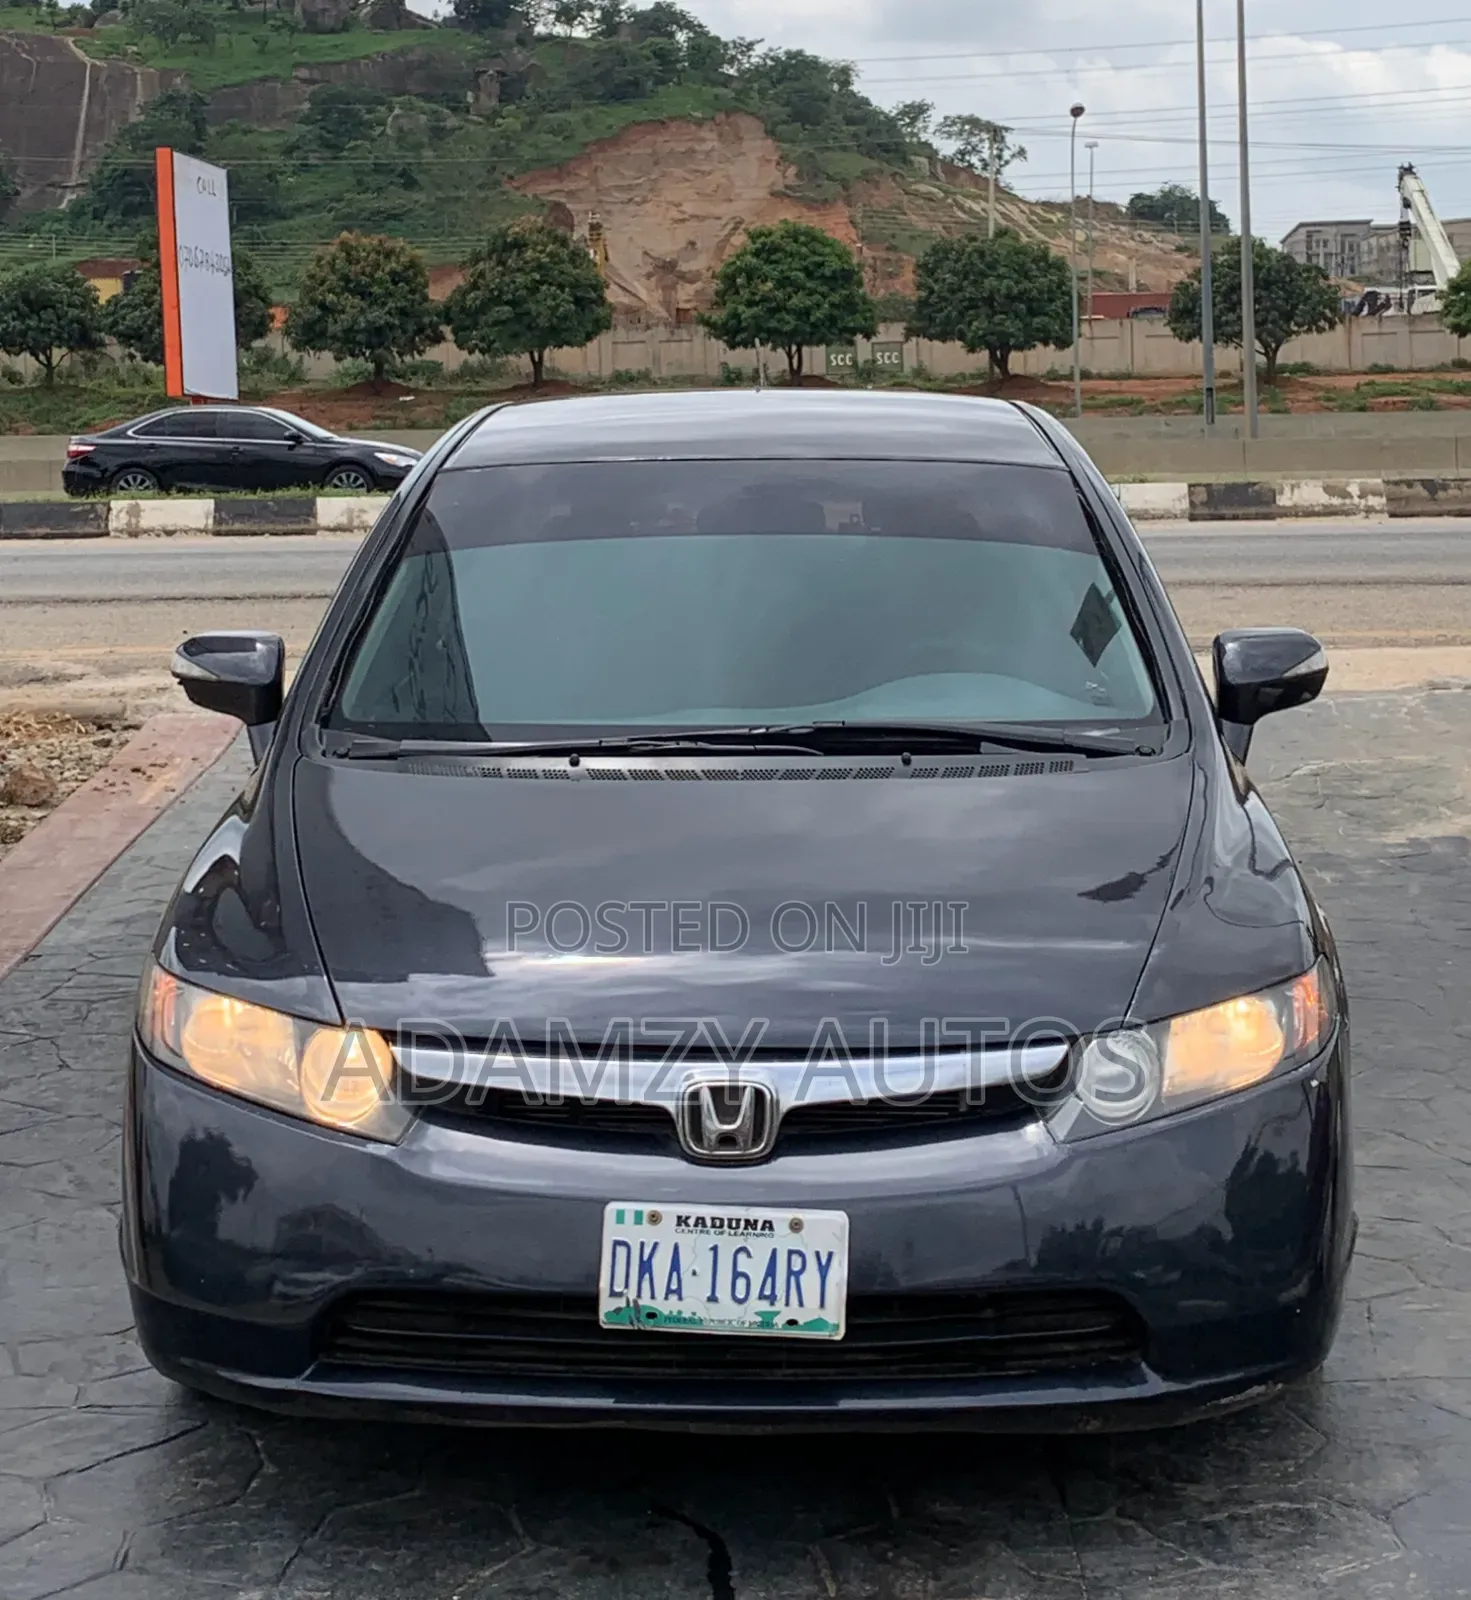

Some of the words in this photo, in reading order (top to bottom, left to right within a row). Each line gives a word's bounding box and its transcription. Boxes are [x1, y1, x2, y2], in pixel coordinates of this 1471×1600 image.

[830, 353, 853, 366] SCC
[876, 351, 900, 364] SCC
[675, 1215, 775, 1232] KADUNA
[675, 1228, 711, 1236] CENTRE
